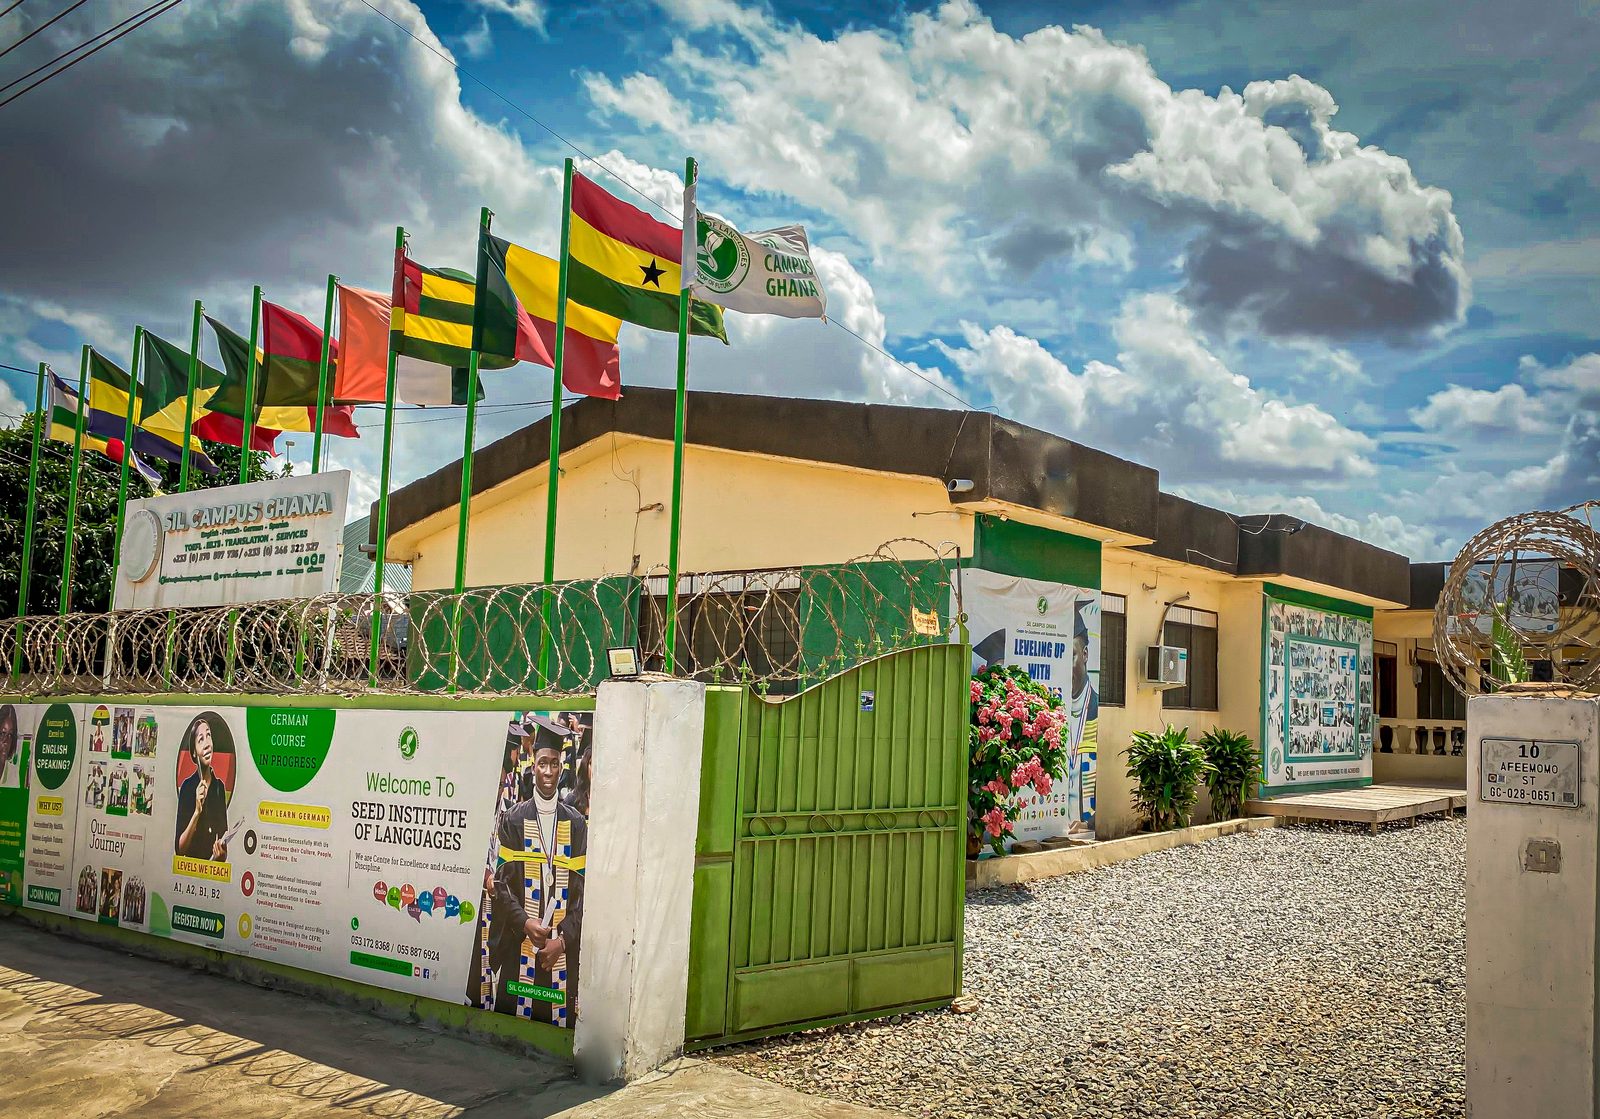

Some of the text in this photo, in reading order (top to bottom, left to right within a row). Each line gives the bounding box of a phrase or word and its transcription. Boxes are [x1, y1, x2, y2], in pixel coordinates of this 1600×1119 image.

[764, 253, 813, 275] CAMPUS
[766, 278, 819, 297] GHANA
[162, 492, 330, 531] SIL CAMPUS GHANA
[225, 535, 268, 547] TRANSLATION
[276, 529, 308, 541] SERVICES
[1014, 639, 1065, 659] LEVELING UP
[1027, 663, 1051, 680] WITH
[270, 713, 308, 726] GERMAN
[271, 734, 306, 747] COURSE
[42, 744, 68, 755] ENGLISH
[1518, 744, 1540, 758] 10
[37, 759, 70, 770] SPEAKING?
[260, 754, 316, 769] IN PROGRESS
[1500, 762, 1558, 774] AFEEMOMO
[1285, 765, 1296, 781] SIL
[1522, 775, 1536, 786] ST
[366, 771, 454, 798] Welcome To
[1490, 786, 1556, 801] GC-028-0651
[39, 800, 62, 811] WHY US?
[260, 808, 330, 823] WHY LEARN GERMAN?
[351, 801, 467, 829] SEED INSTITUTE
[91, 818, 107, 835] Our
[273, 835, 287, 843] German
[288, 837, 312, 847] Successfully
[354, 822, 462, 851] OF LANGUAGES
[89, 834, 125, 858] Journey
[268, 844, 289, 852] Experience
[177, 860, 229, 877] LEVELS WE TEACH
[355, 852, 471, 874] We are Centre for Excellence and Academic
[29, 889, 60, 903] JOIN NOW
[173, 882, 220, 899] A1, A2, B1, B2
[173, 911, 216, 932] REGISTER NOW
[350, 935, 362, 946] 053
[363, 937, 374, 948] 172
[375, 940, 390, 952] 8368
[397, 944, 409, 955] 055
[409, 946, 422, 957] 887
[423, 949, 440, 961] 6924
[508, 983, 563, 1000] SIL CAMPUS GHANA
